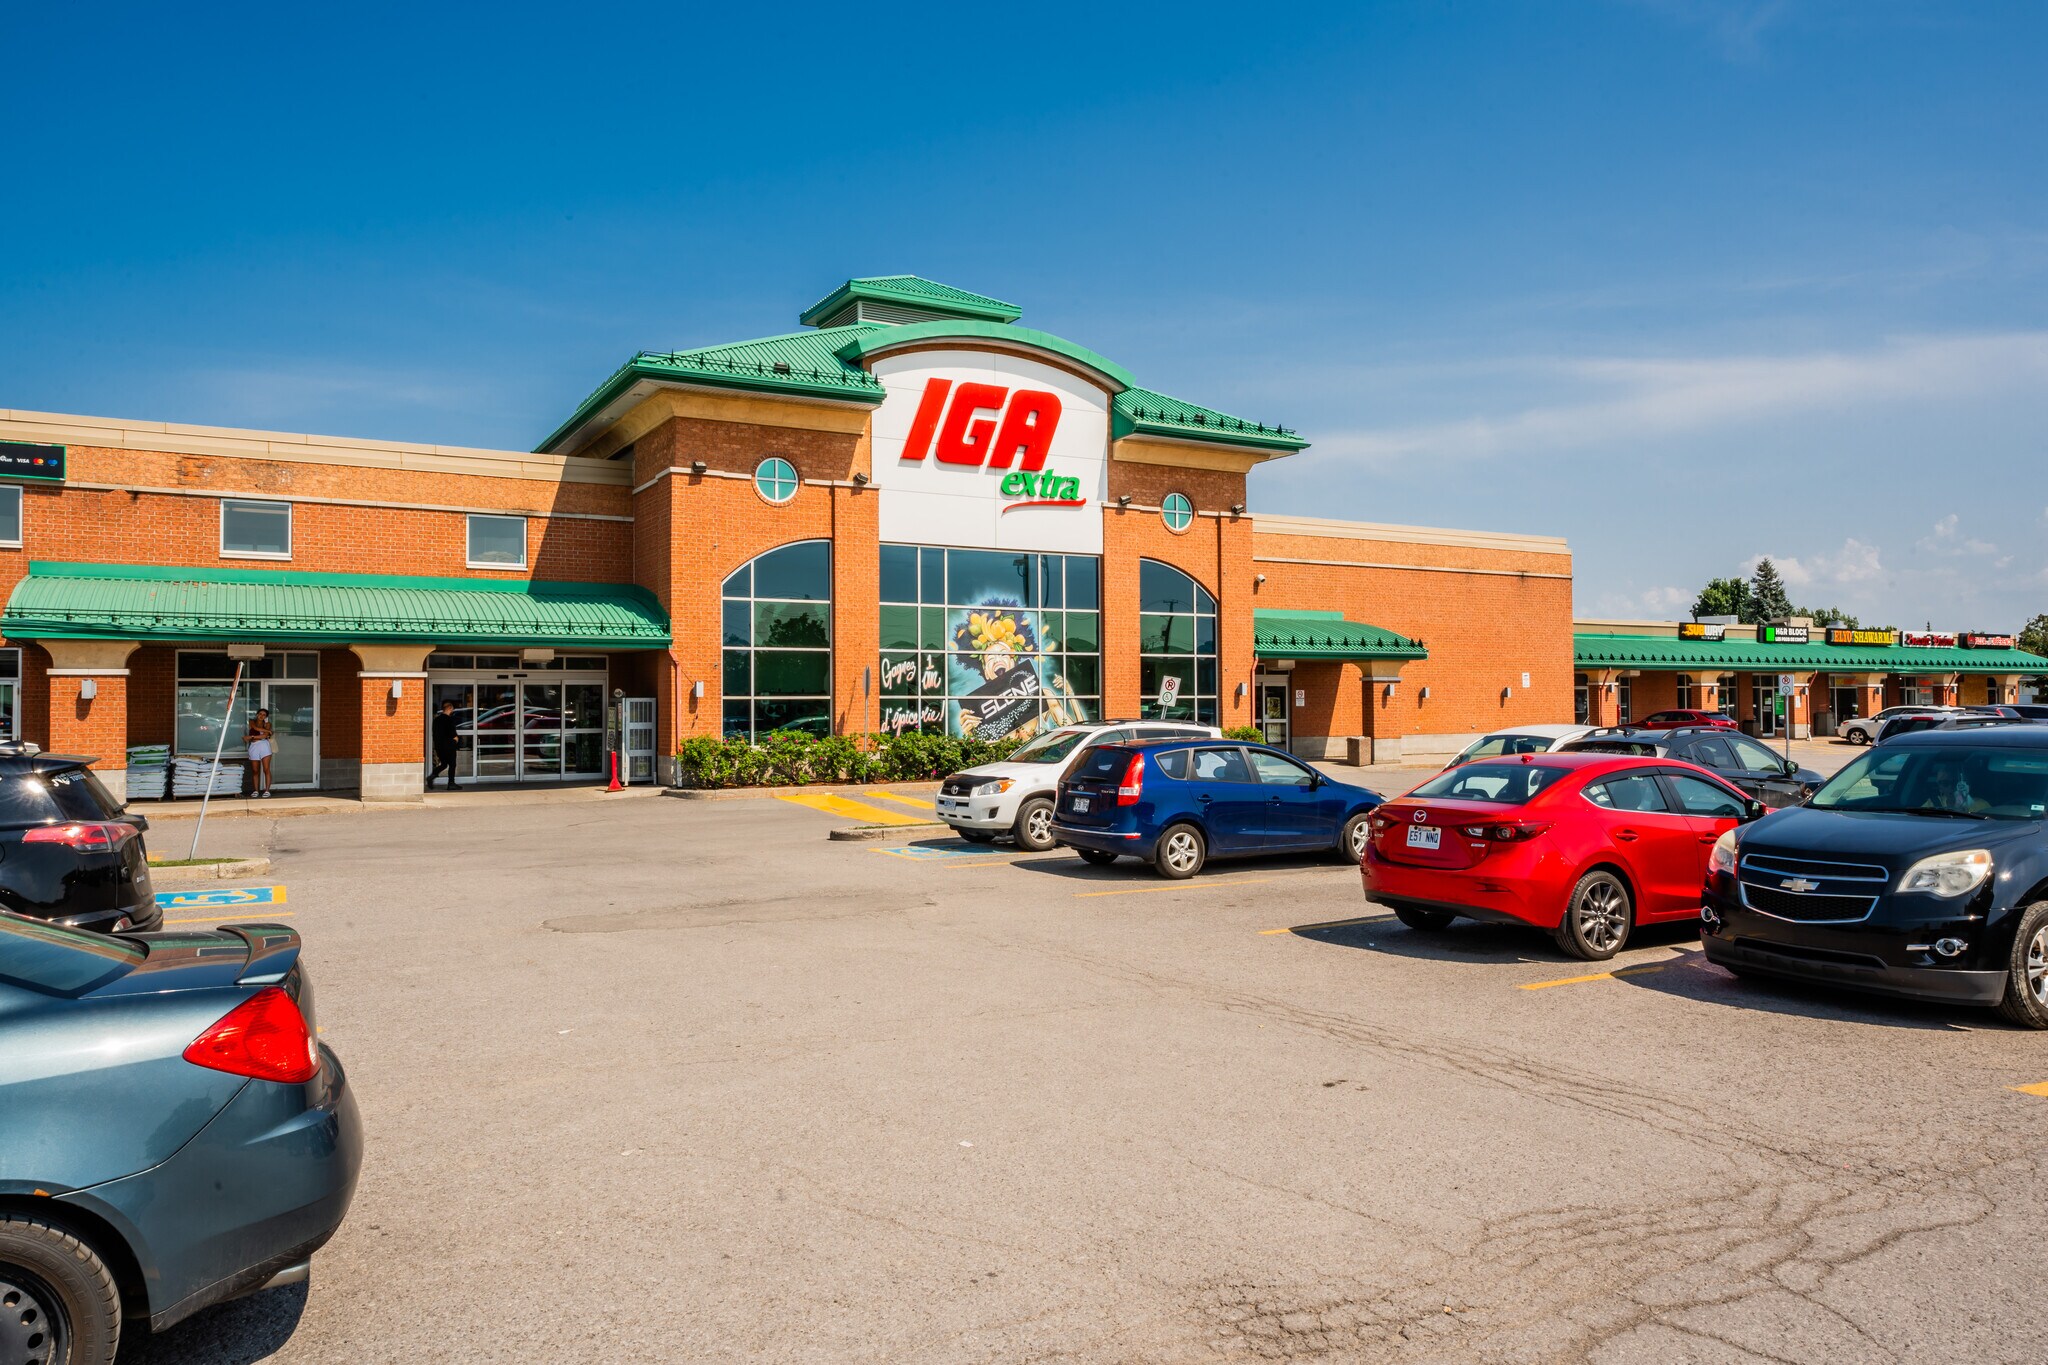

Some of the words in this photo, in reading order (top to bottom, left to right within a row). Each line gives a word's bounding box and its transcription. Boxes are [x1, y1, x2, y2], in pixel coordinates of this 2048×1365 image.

[899, 377, 1063, 471] IGA
[1000, 468, 1081, 501] extra
[1682, 624, 1726, 637] SUBWAY
[1775, 627, 1788, 636] H&R
[1788, 628, 1807, 636] BLOCK
[1834, 630, 1852, 643] ELYO
[1853, 631, 1894, 644] SHAWARMA
[926, 654, 935, 670] 1
[881, 658, 917, 690] Gagnez
[921, 670, 942, 690] an
[1409, 831, 1422, 841] E51
